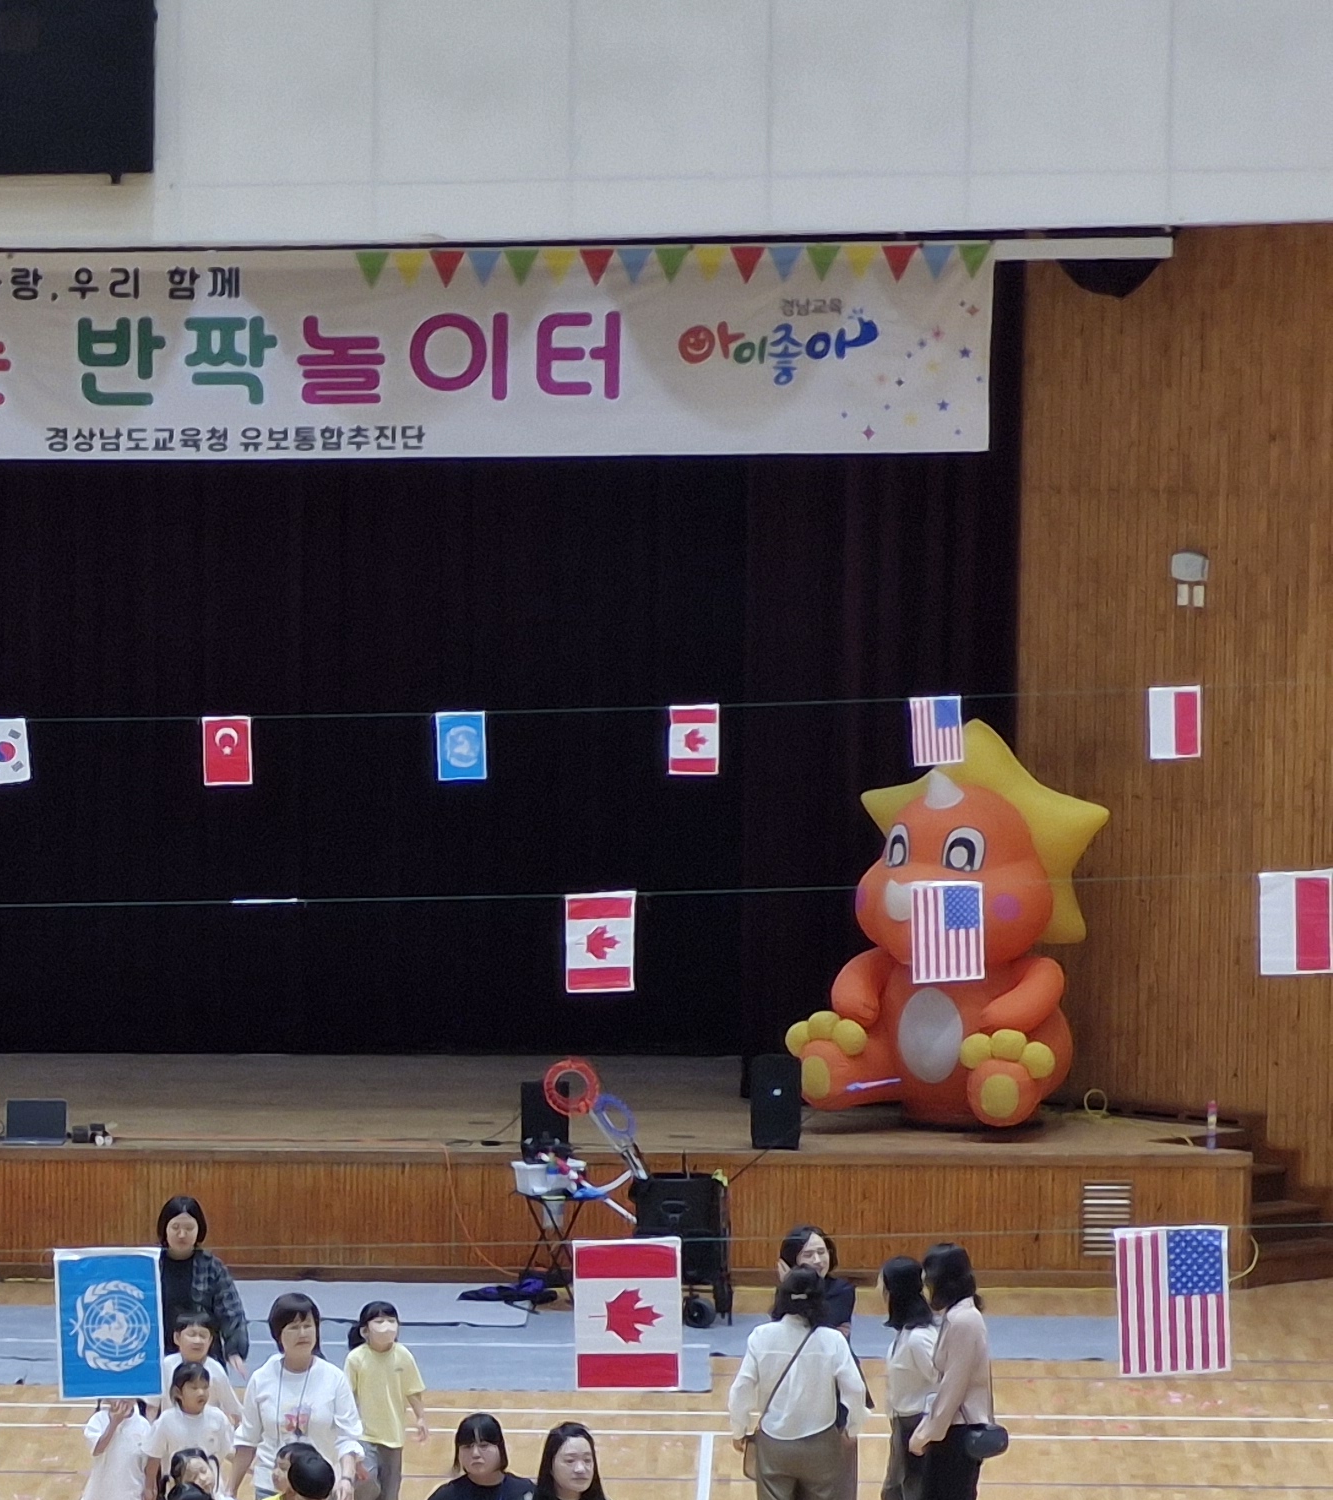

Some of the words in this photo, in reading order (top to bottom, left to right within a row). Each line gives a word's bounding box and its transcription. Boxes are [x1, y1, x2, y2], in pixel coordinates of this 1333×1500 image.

[166, 265, 241, 301] 함께
[781, 297, 843, 317] 경남교육
[677, 318, 880, 386] 아이좋아
[44, 426, 229, 453] 경상남도교육청
[238, 424, 427, 452] 유보통합추진단
